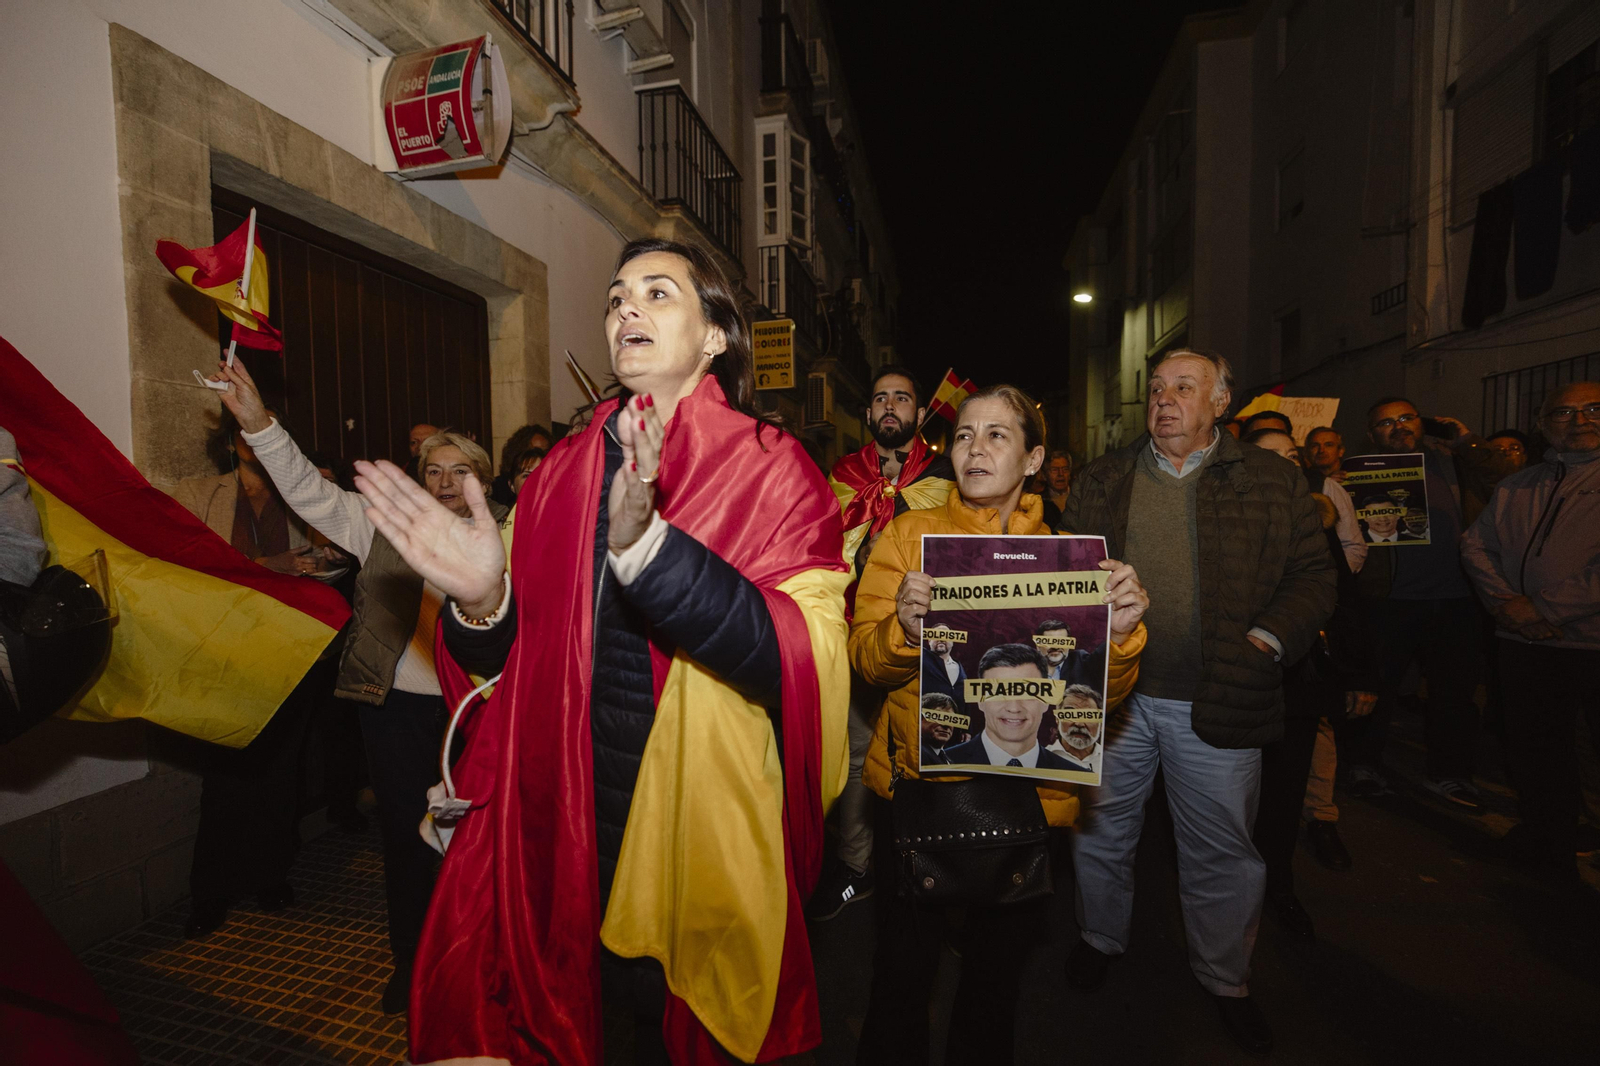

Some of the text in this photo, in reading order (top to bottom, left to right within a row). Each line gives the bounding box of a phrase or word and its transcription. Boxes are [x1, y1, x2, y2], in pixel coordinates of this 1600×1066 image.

[398, 77, 424, 93] PSOE
[397, 127, 409, 137] EL
[400, 135, 431, 149] PUERTO
[755, 337, 791, 348] COLORES
[756, 362, 791, 371] MANOLO
[1359, 508, 1402, 517] TRAIDOR
[993, 552, 1037, 560] Revuelta.
[932, 580, 1100, 601] TRAIDORES A LA PATRIA
[922, 630, 967, 642] GOLPISTA
[1035, 637, 1075, 647] GOLPISTA
[970, 682, 1053, 697] TRAIDOR
[924, 711, 970, 727] GOLPISTA
[1057, 711, 1103, 720] GOLPISTA
